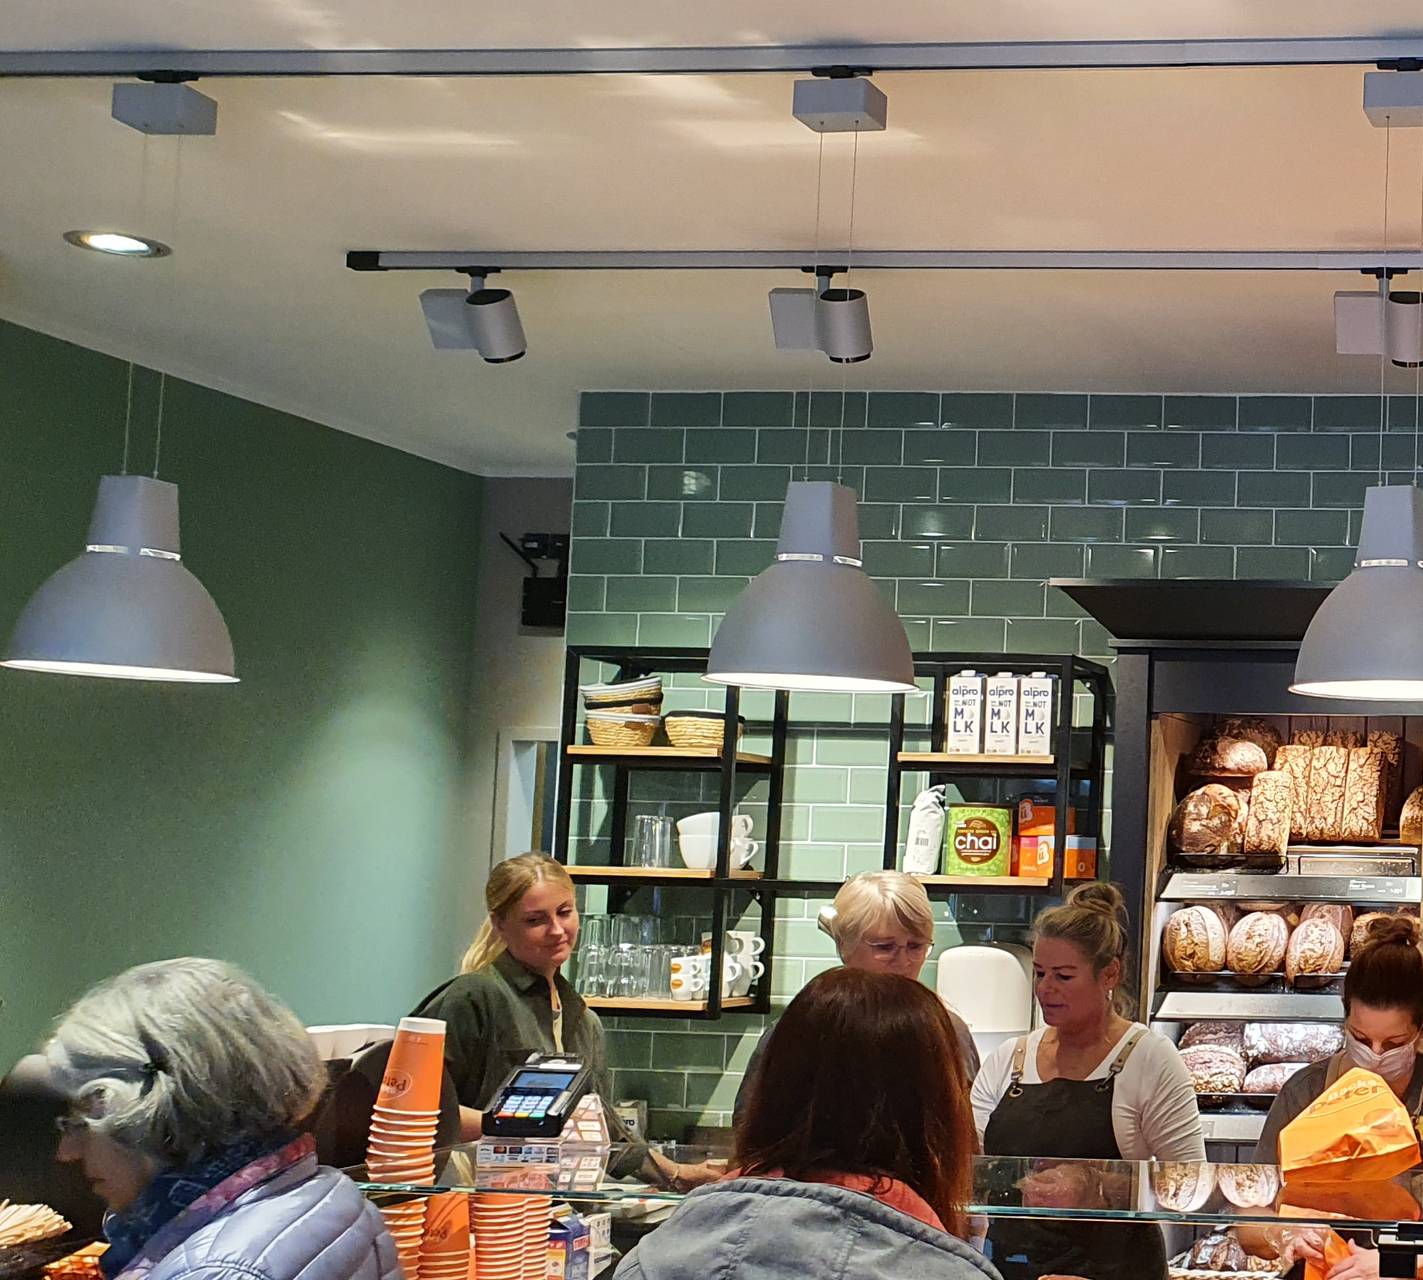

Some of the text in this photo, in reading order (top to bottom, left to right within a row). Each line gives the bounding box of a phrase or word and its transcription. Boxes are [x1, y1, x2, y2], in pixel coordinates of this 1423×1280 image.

[952, 686, 978, 697] alpro
[989, 686, 1014, 698] alpro
[1023, 687, 1049, 699] alpro
[955, 832, 997, 850] chai
